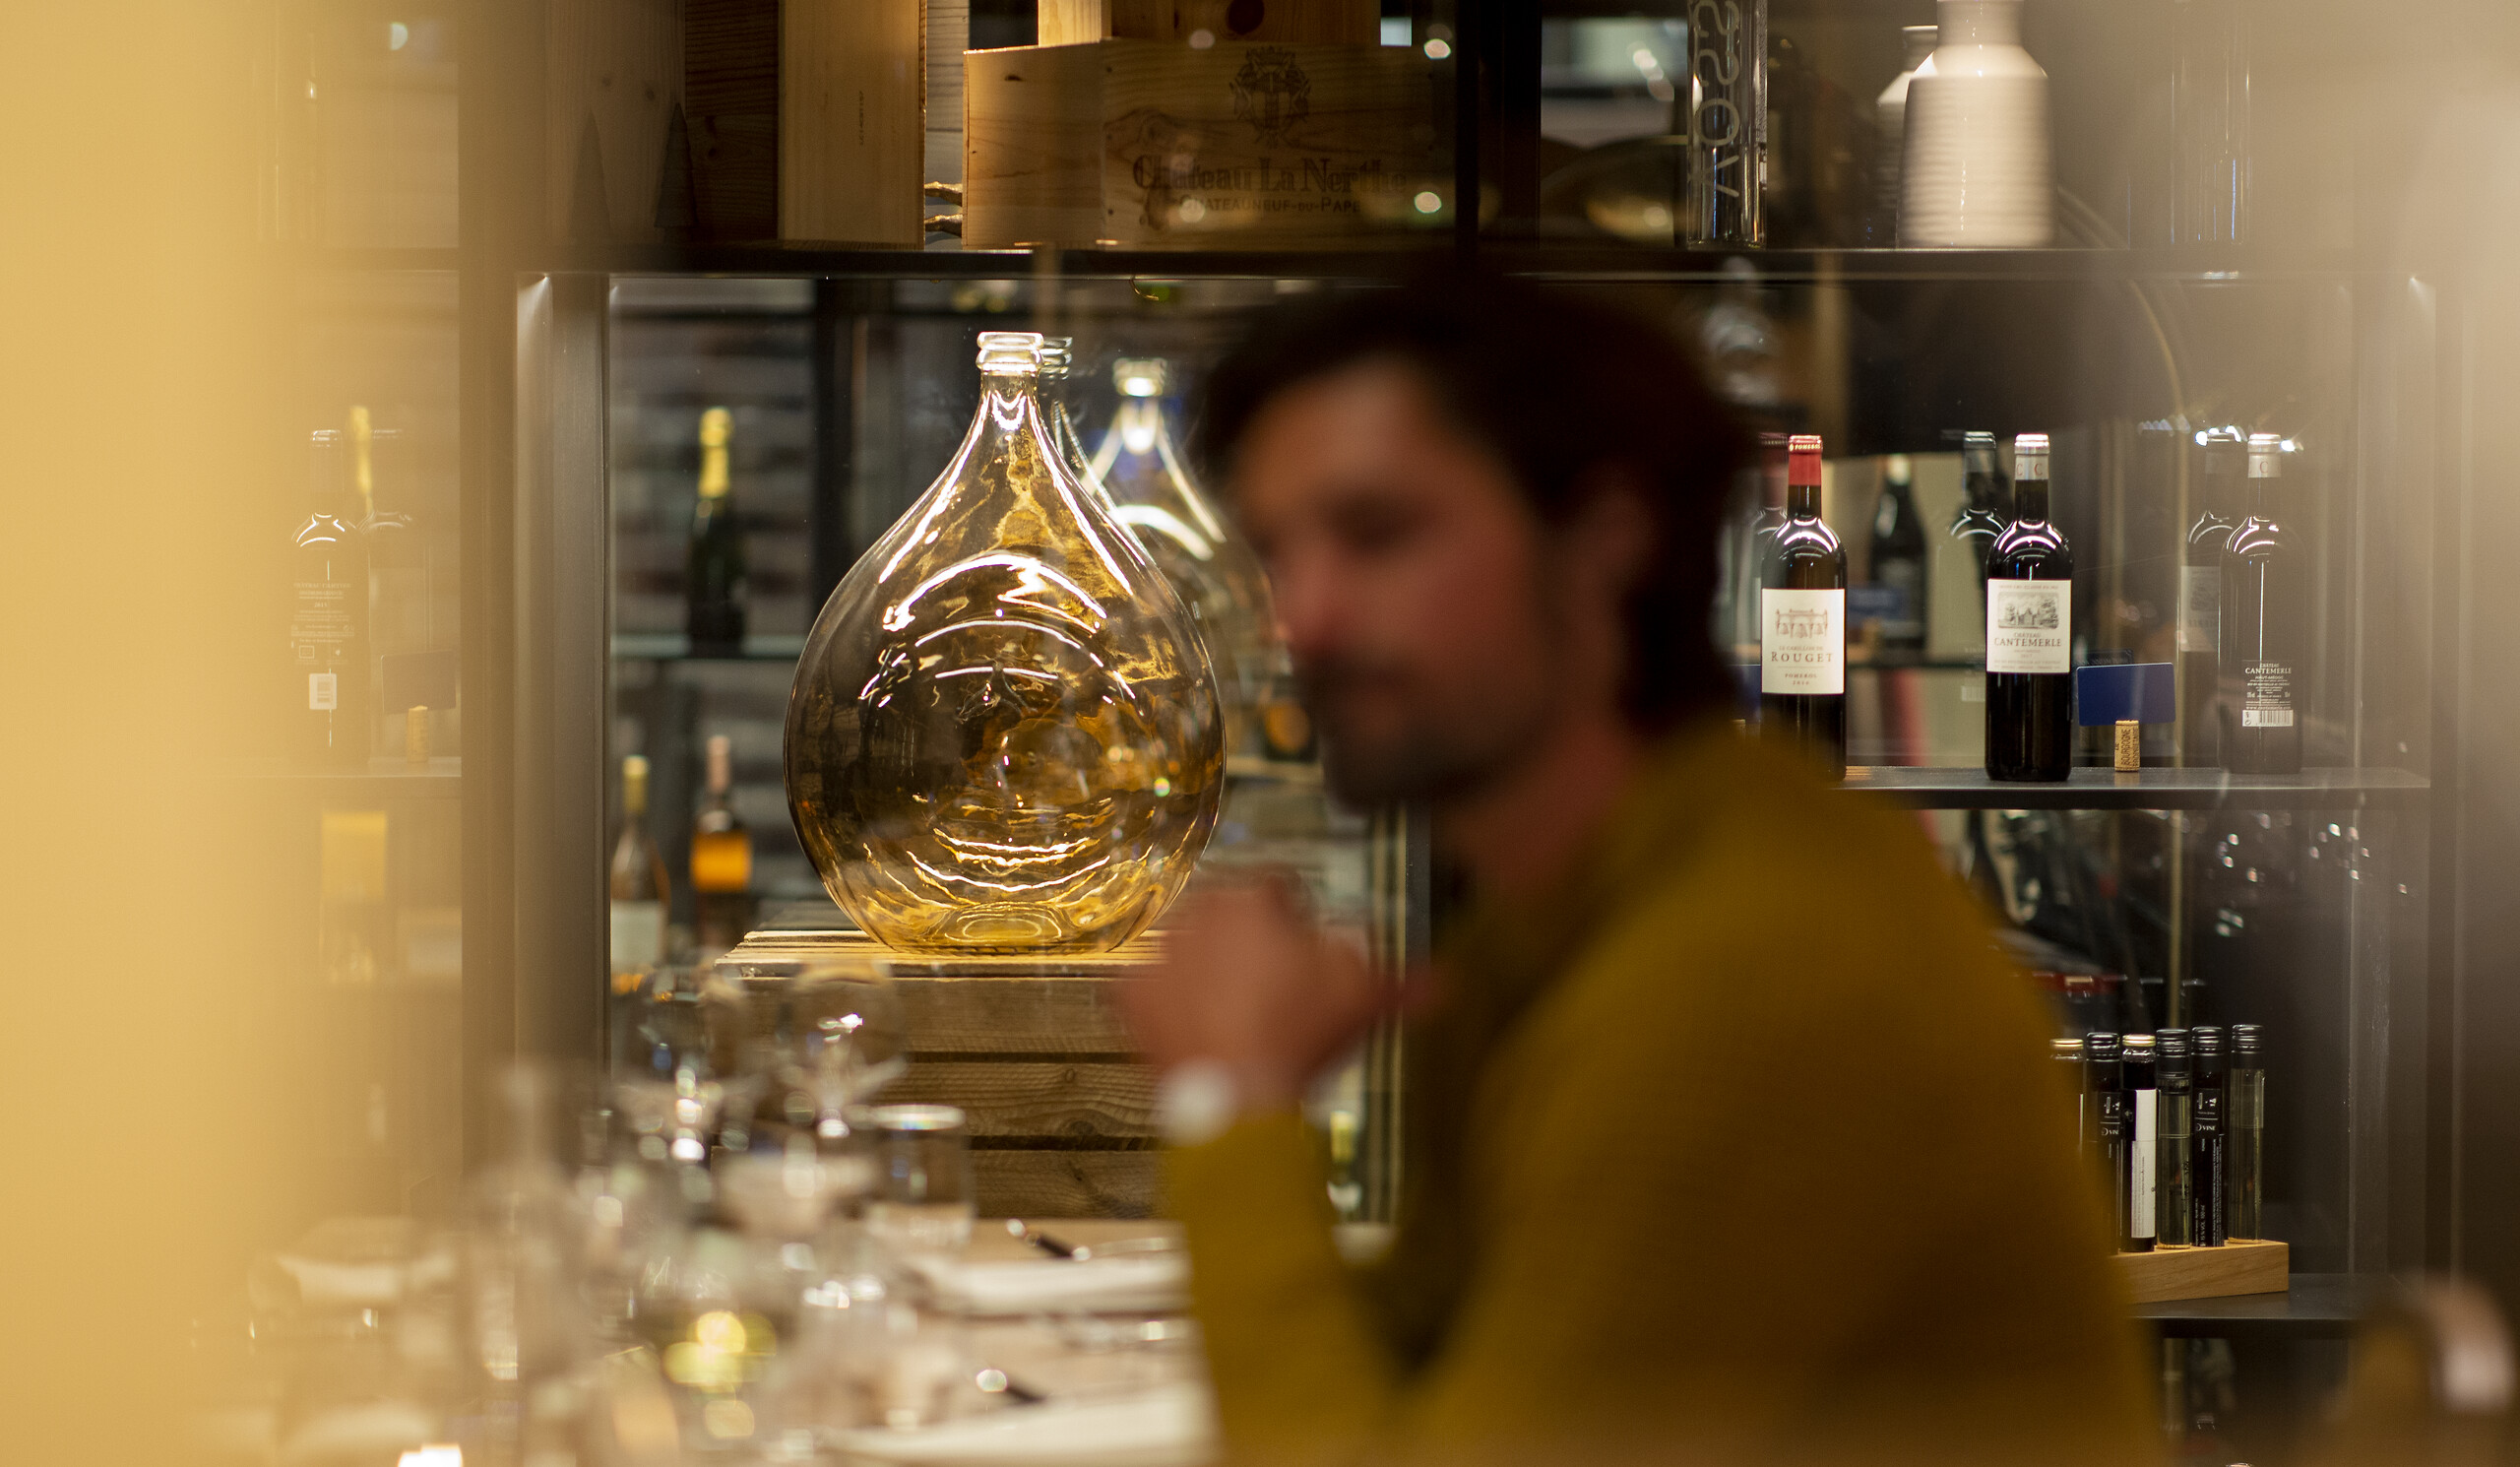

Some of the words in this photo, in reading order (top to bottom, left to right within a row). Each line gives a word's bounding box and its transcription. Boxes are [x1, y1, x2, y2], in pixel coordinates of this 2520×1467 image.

[1259, 157, 1296, 191] La
[1994, 637, 2061, 647] CANTEMERLE
[1771, 651, 1833, 663] ROUGET
